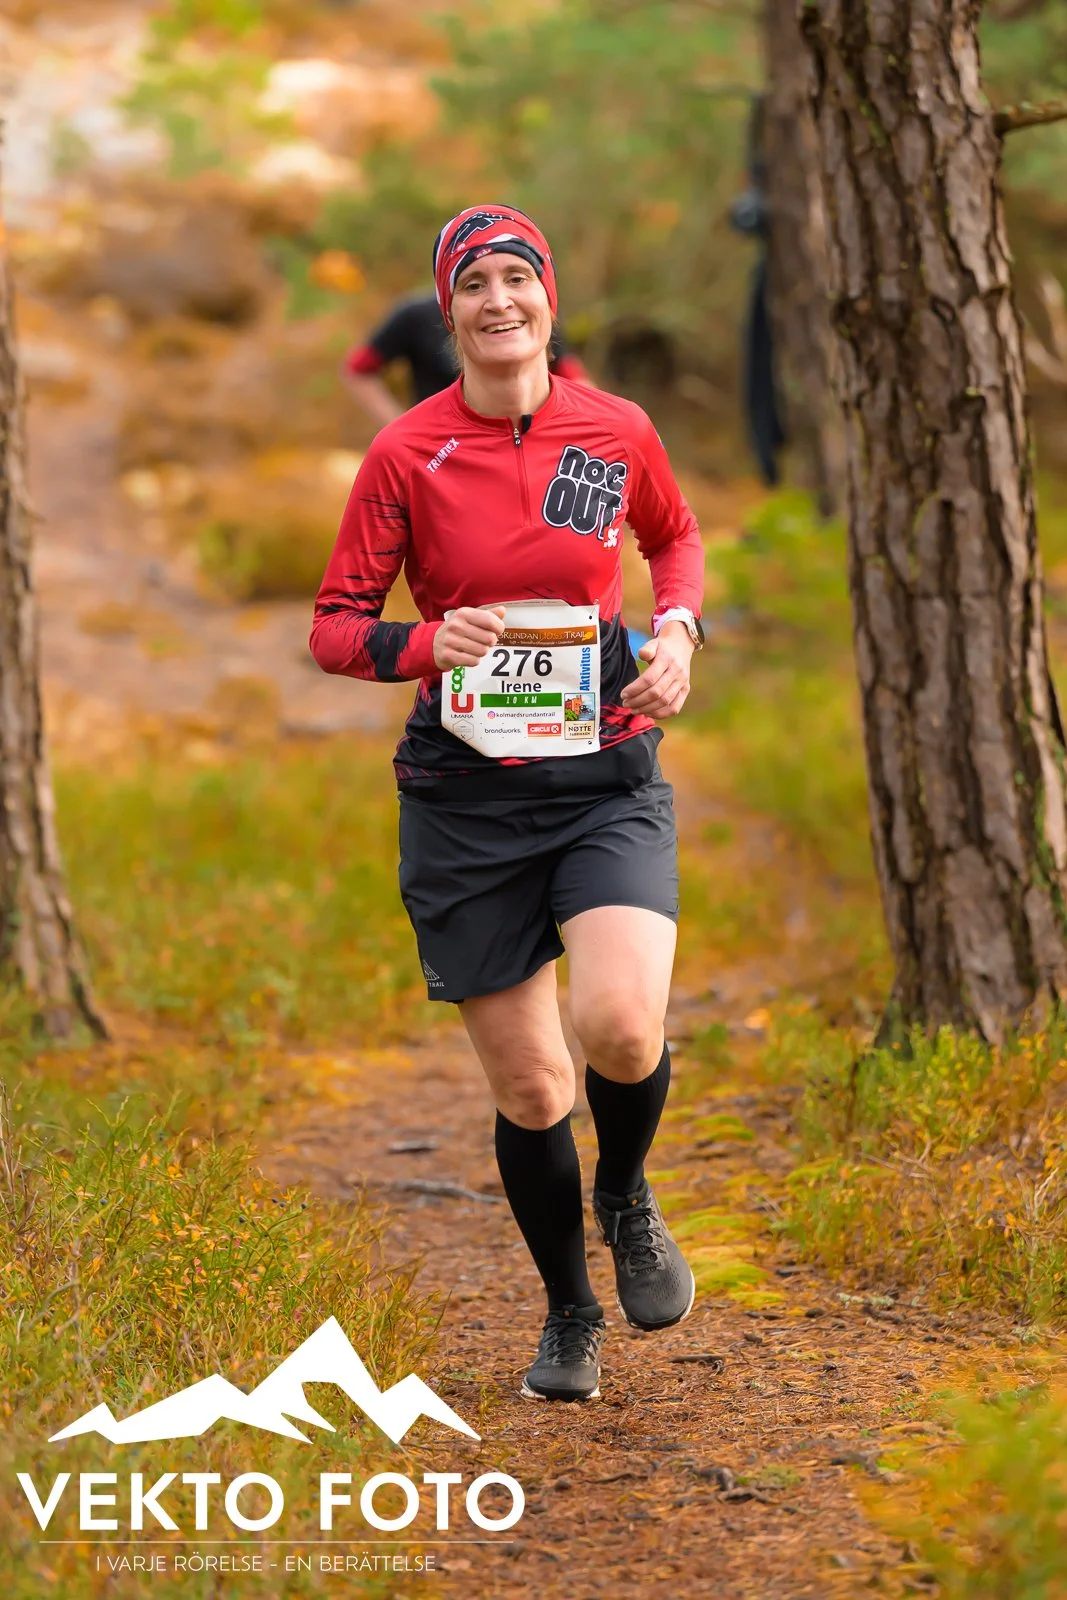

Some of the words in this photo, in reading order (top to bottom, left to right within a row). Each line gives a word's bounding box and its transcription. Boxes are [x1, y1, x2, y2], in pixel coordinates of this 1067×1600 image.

[426, 437, 460, 473] TRIMTEX
[542, 475, 622, 540] OUT
[564, 631, 586, 639] TRAIL
[491, 649, 553, 677] 276
[579, 647, 591, 691] Aktivitus
[501, 680, 542, 693] Irene
[506, 696, 517, 705] 10
[524, 696, 538, 705] KM
[552, 725, 559, 733] K
